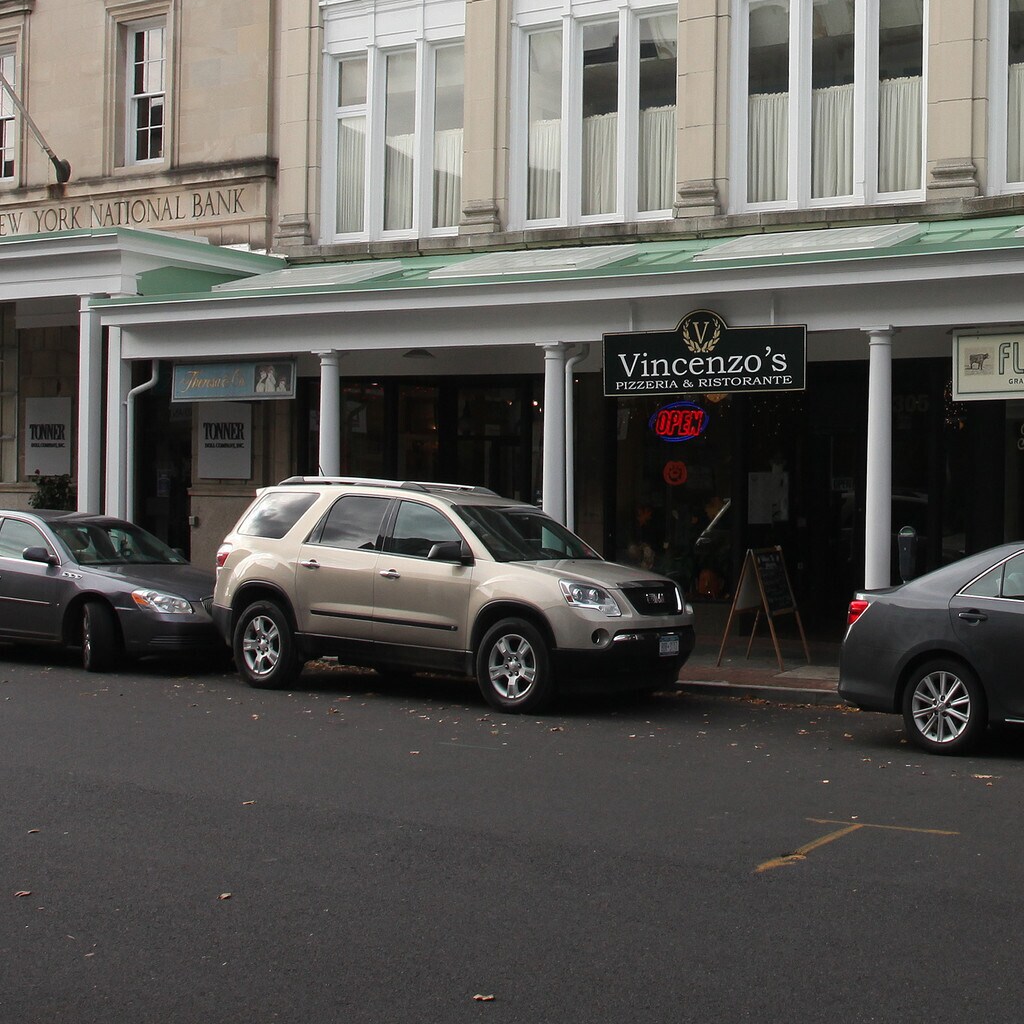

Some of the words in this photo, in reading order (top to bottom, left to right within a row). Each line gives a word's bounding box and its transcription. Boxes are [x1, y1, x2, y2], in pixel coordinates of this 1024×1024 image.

[0, 212, 23, 236] EW
[34, 206, 83, 233] YORK
[90, 195, 186, 228] NATIONAL
[192, 188, 245, 218] BANK
[692, 321, 710, 344] V
[617, 346, 788, 377] Vincenzo's
[616, 379, 678, 390] PIZZERIA
[683, 379, 694, 388] &
[698, 376, 793, 388] RISTORANTE
[29, 423, 66, 441] TONNER
[202, 422, 245, 440] TONNER
[655, 409, 705, 437] OPEN
